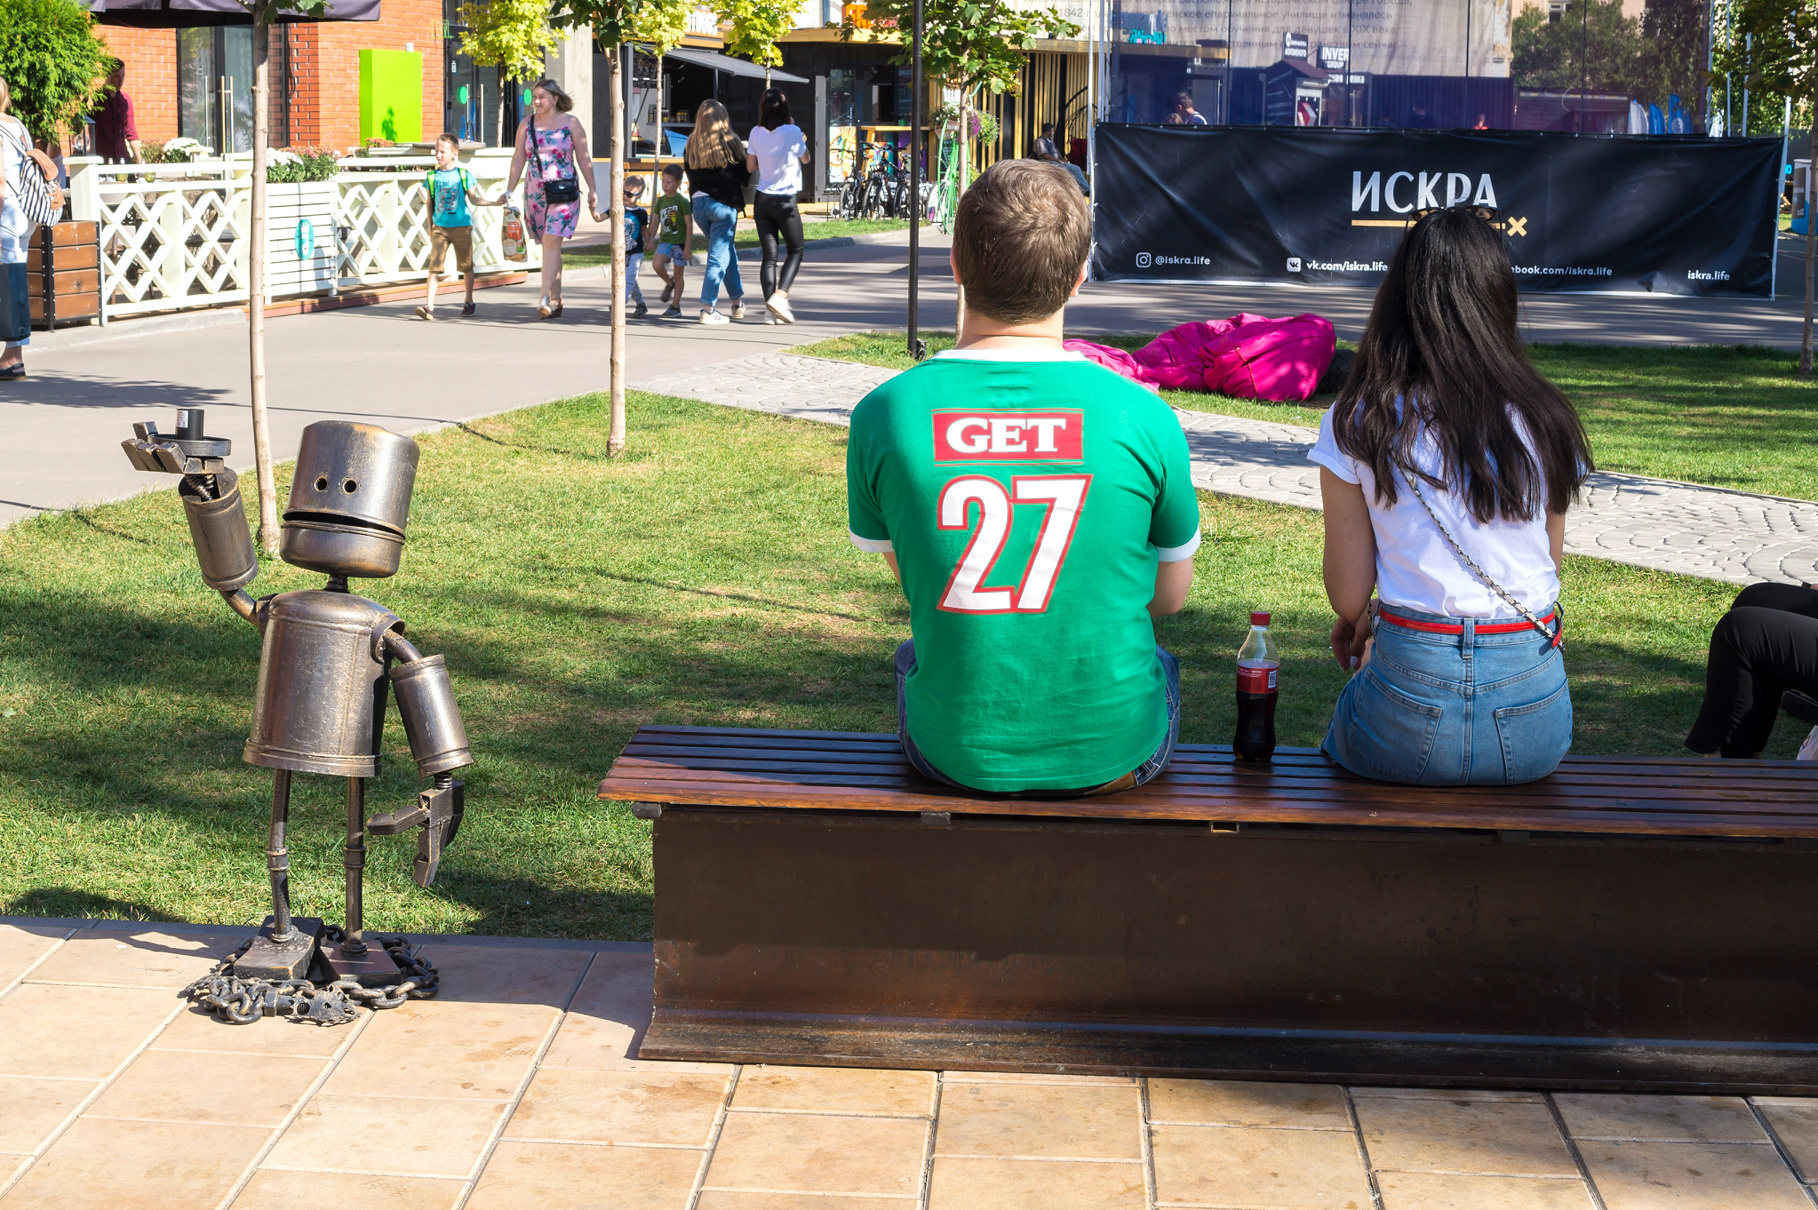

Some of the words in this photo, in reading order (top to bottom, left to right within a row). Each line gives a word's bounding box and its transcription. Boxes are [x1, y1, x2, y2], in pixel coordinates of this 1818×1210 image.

[1281, 11, 1328, 21] училище
[1179, 25, 1217, 34] местом
[1220, 25, 1271, 36] оучения
[1351, 170, 1498, 213] ИСКРА
[1155, 255, 1211, 266] @iskra.life
[1306, 260, 1389, 272] vk.com/iskra.life
[1687, 269, 1731, 281] iskra.life
[945, 417, 1067, 454] GET
[937, 475, 1093, 614] 27
